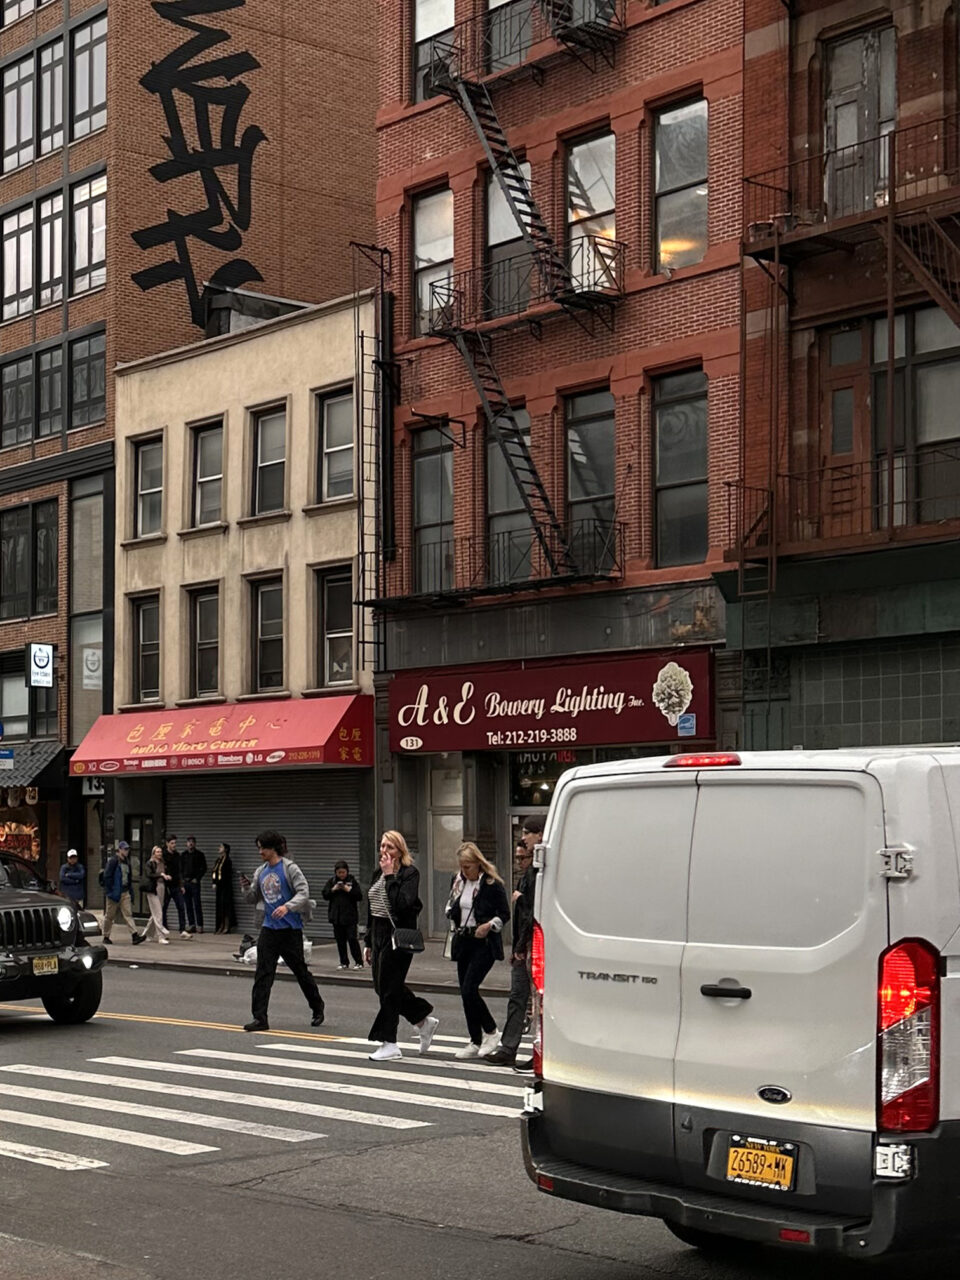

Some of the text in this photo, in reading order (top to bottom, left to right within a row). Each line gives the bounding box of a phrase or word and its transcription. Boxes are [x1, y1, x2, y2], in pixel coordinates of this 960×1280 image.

[398, 684, 430, 727] A
[433, 696, 449, 726] &
[453, 681, 476, 725] E
[484, 692, 546, 719] Bowery
[550, 686, 626, 718] Lighting
[339, 727, 362, 742] 包厘
[486, 728, 577, 745] Tel: 212-219-3888
[129, 739, 259, 755] AUDIO VIDEO CENTER
[405, 738, 419, 748] 131
[187, 758, 205, 766] BOSCH
[254, 753, 263, 762] LG
[339, 747, 363, 762] 家電
[578, 971, 639, 983] TRANSIT
[763, 1089, 784, 1101] Ford
[731, 1149, 767, 1175] 26589
